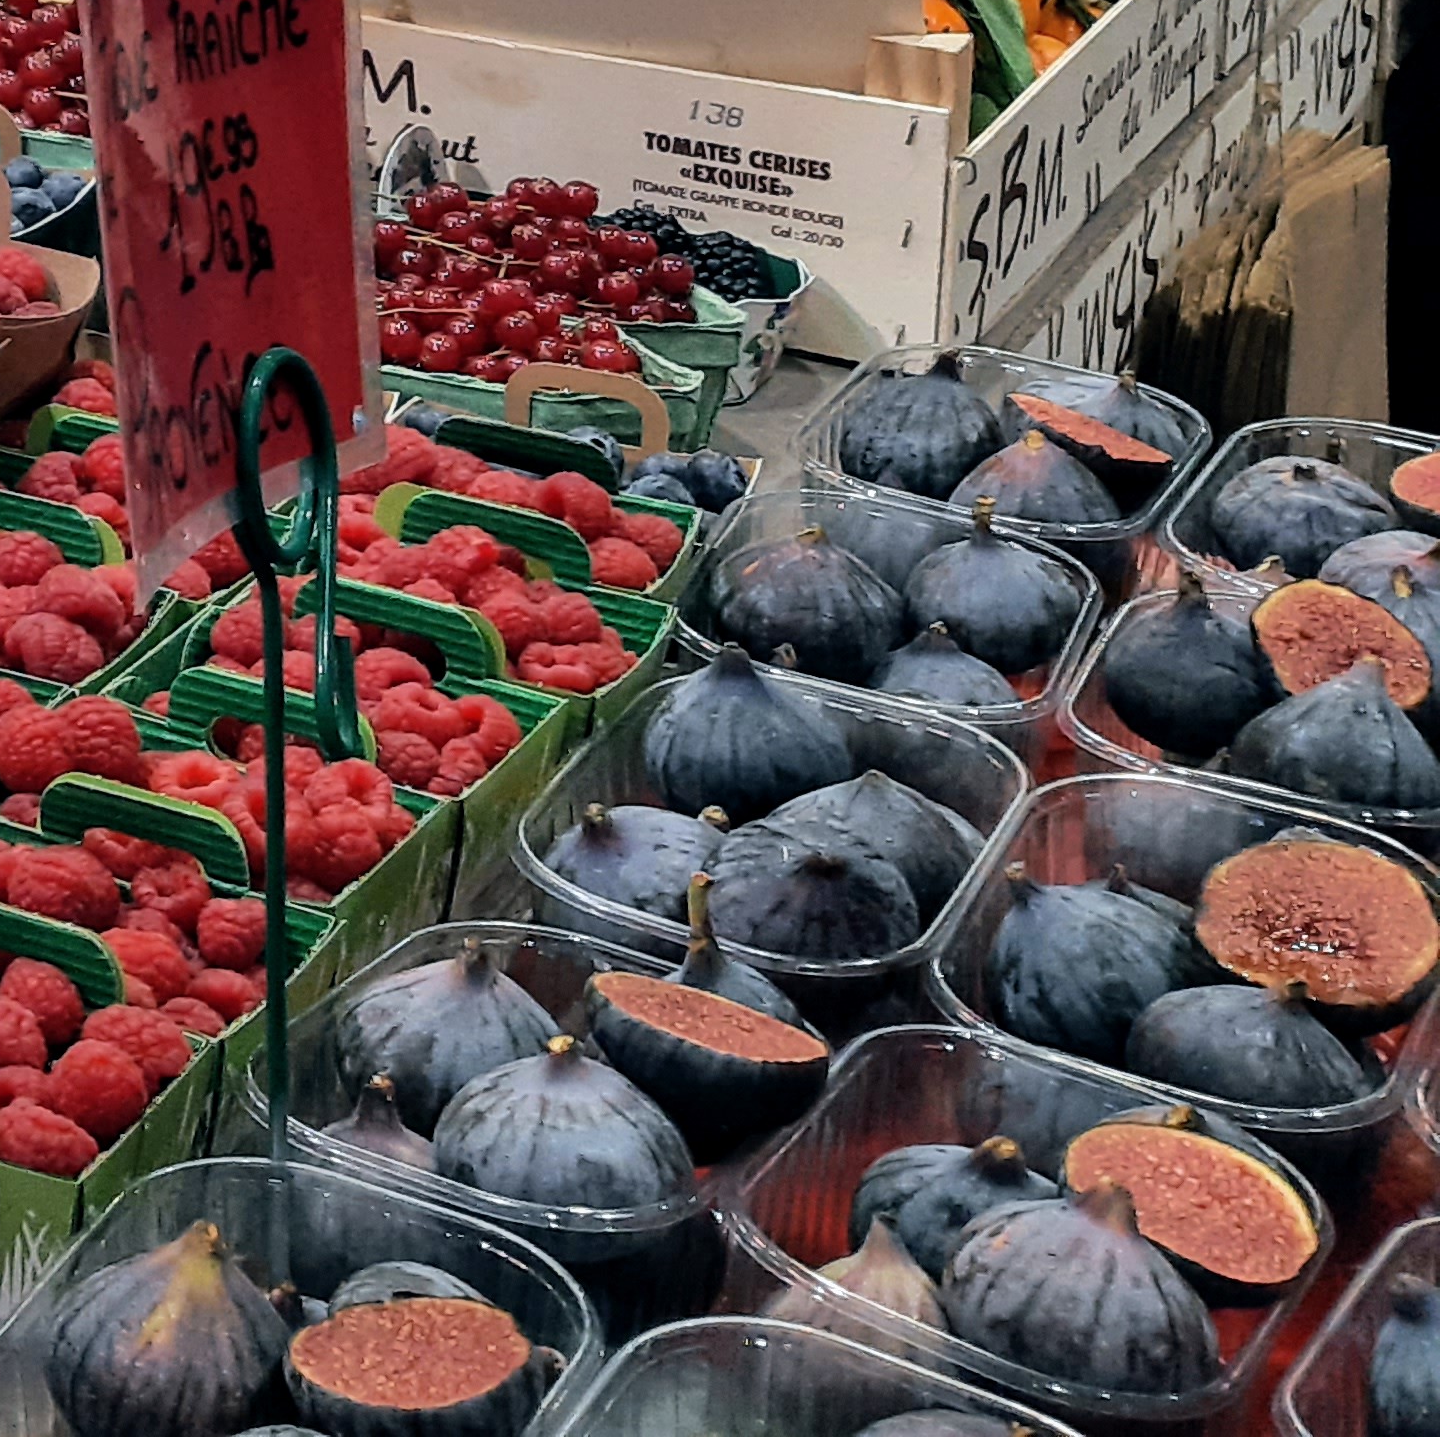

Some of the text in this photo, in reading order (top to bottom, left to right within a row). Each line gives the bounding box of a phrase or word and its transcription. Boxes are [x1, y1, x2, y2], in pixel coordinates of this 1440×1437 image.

[689, 100, 744, 128] 138
[644, 132, 831, 181] TOMATES CERISES
[680, 164, 794, 198] «EXQUISE»
[967, 124, 1067, 315] S.B.M.
